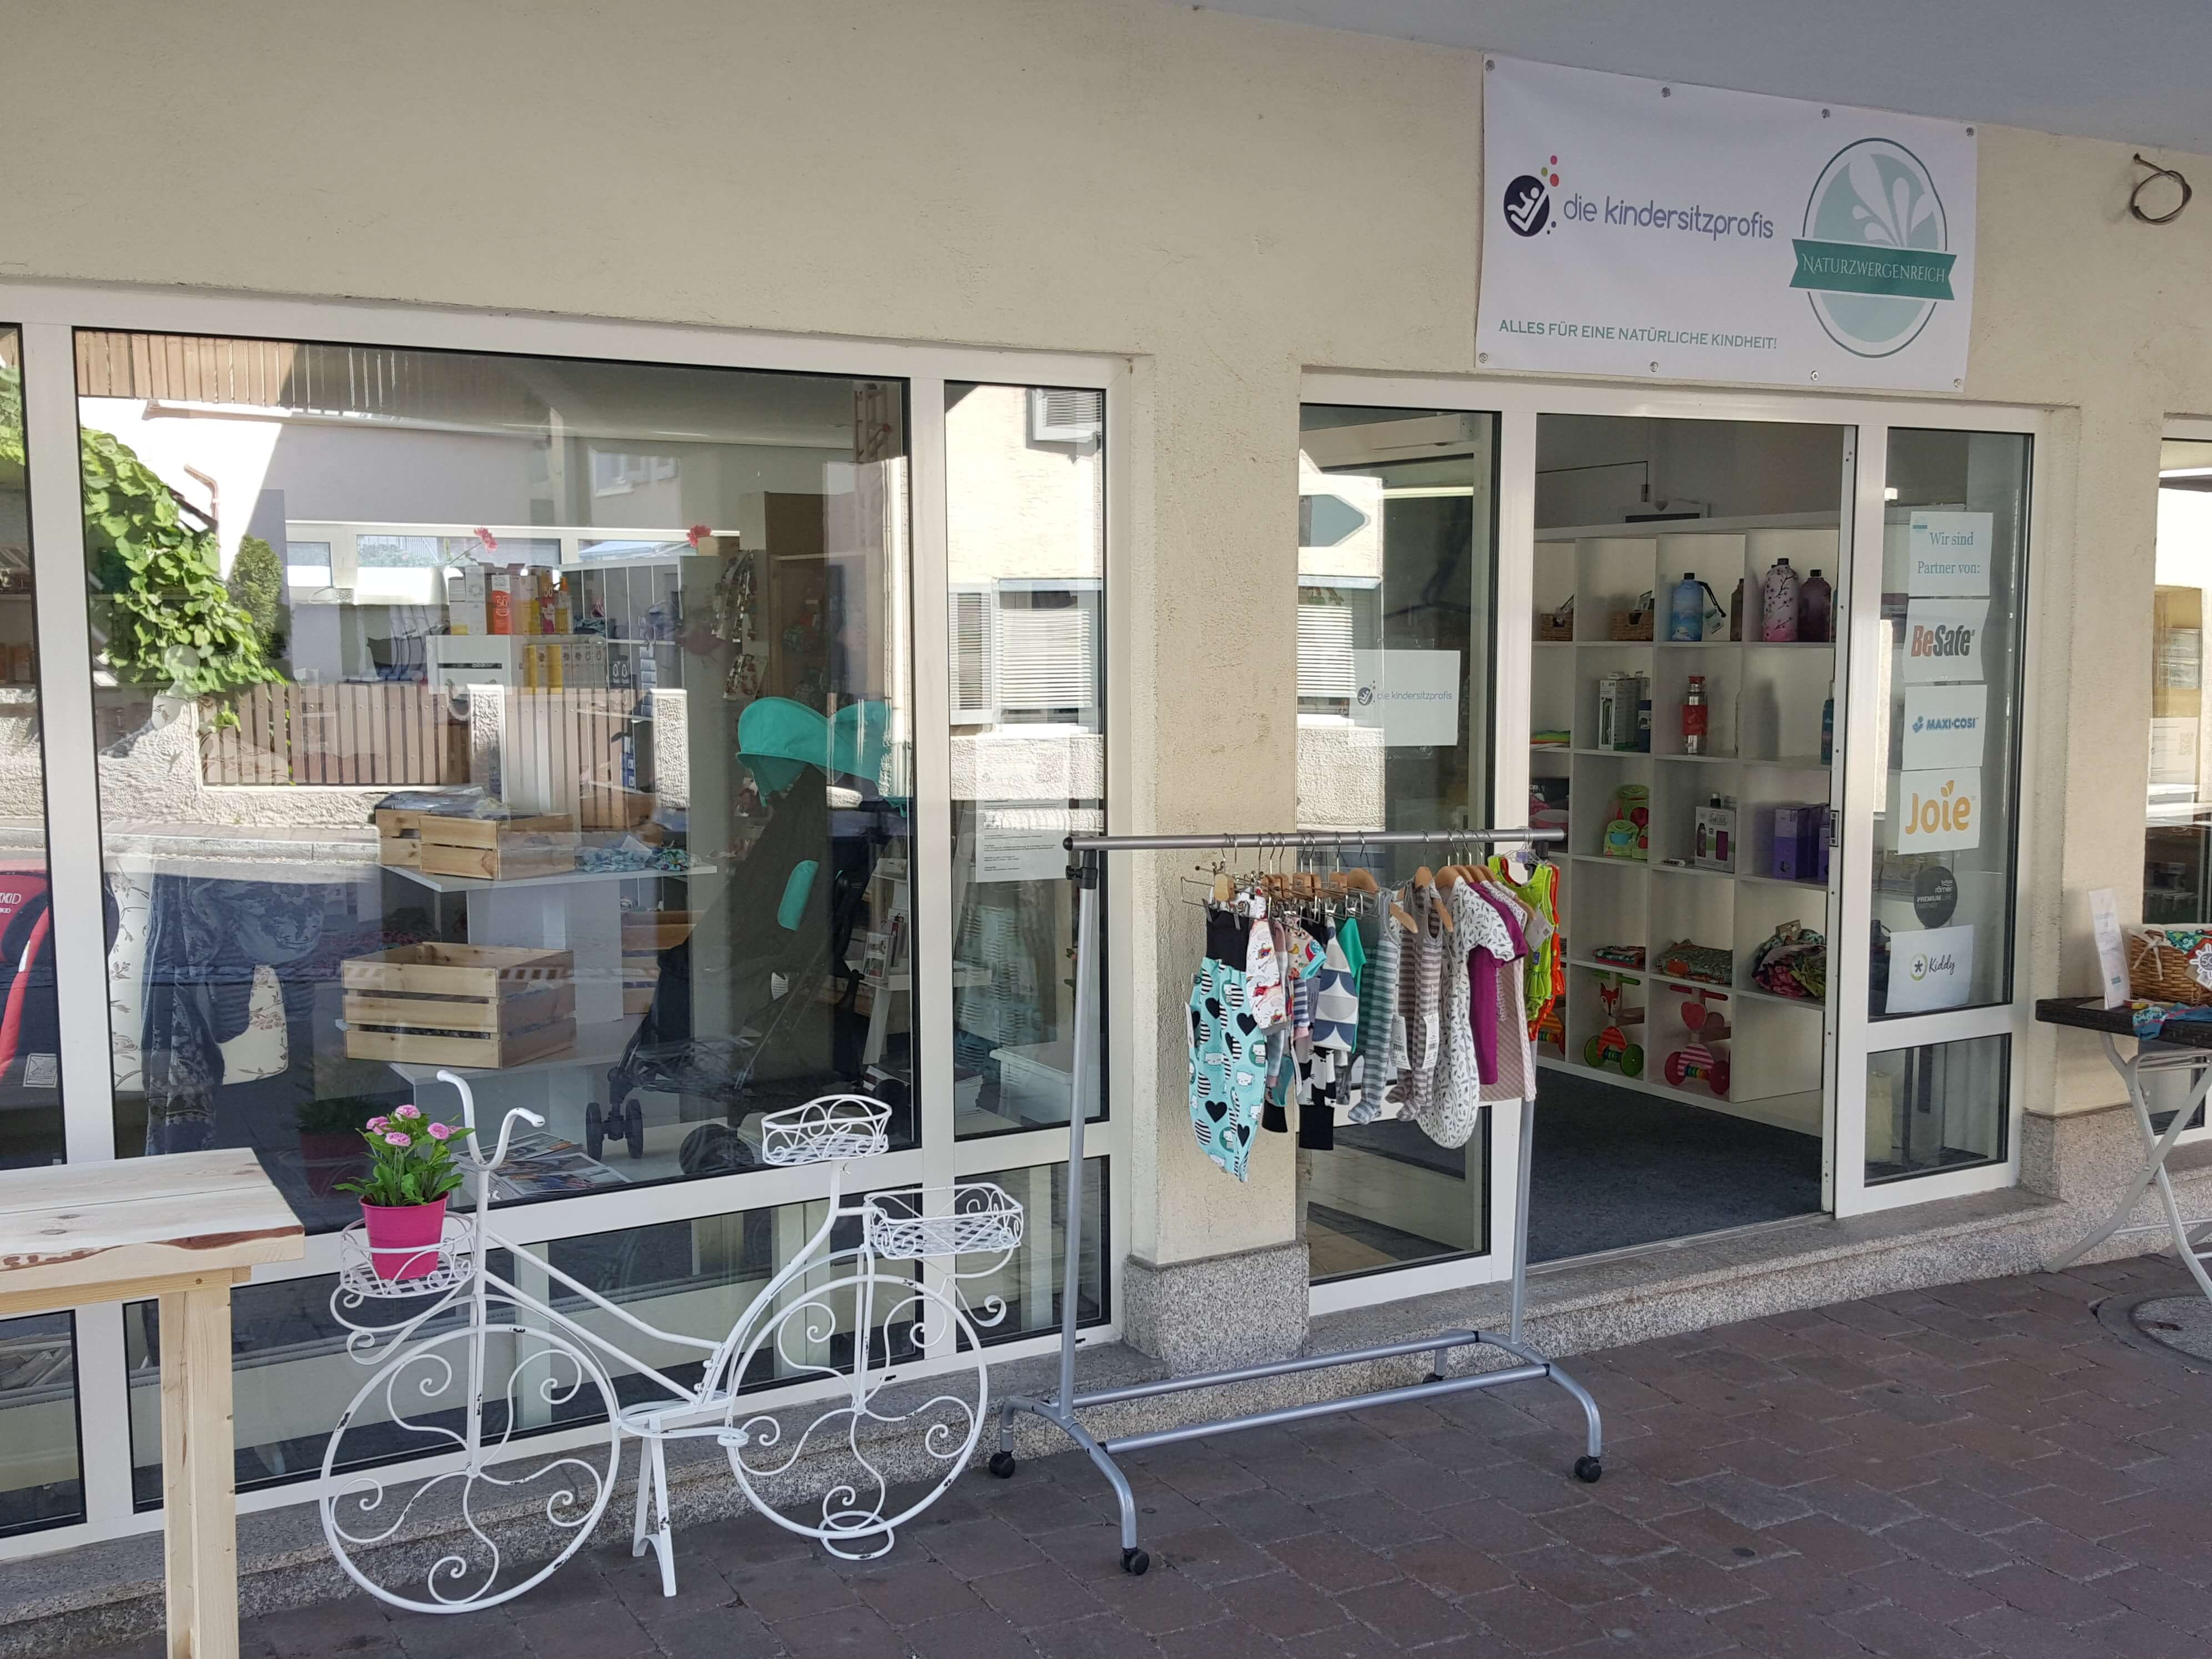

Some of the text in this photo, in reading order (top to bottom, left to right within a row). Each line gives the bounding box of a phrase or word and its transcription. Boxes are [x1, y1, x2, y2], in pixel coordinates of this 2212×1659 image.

[1564, 193, 1774, 241] die kindersitzprofis
[1802, 254, 1945, 283] NATURZWERGENREICH
[1499, 319, 1777, 349] ALLES FÜR EINE NATÜRLICHE KINDHEIT!
[1929, 532, 1974, 546] Wir sind
[1917, 561, 1980, 574] Partner von:
[1911, 625, 1970, 657] BeSafe
[1905, 780, 1970, 834] Joie
[1928, 954, 1955, 976] Kiddy
